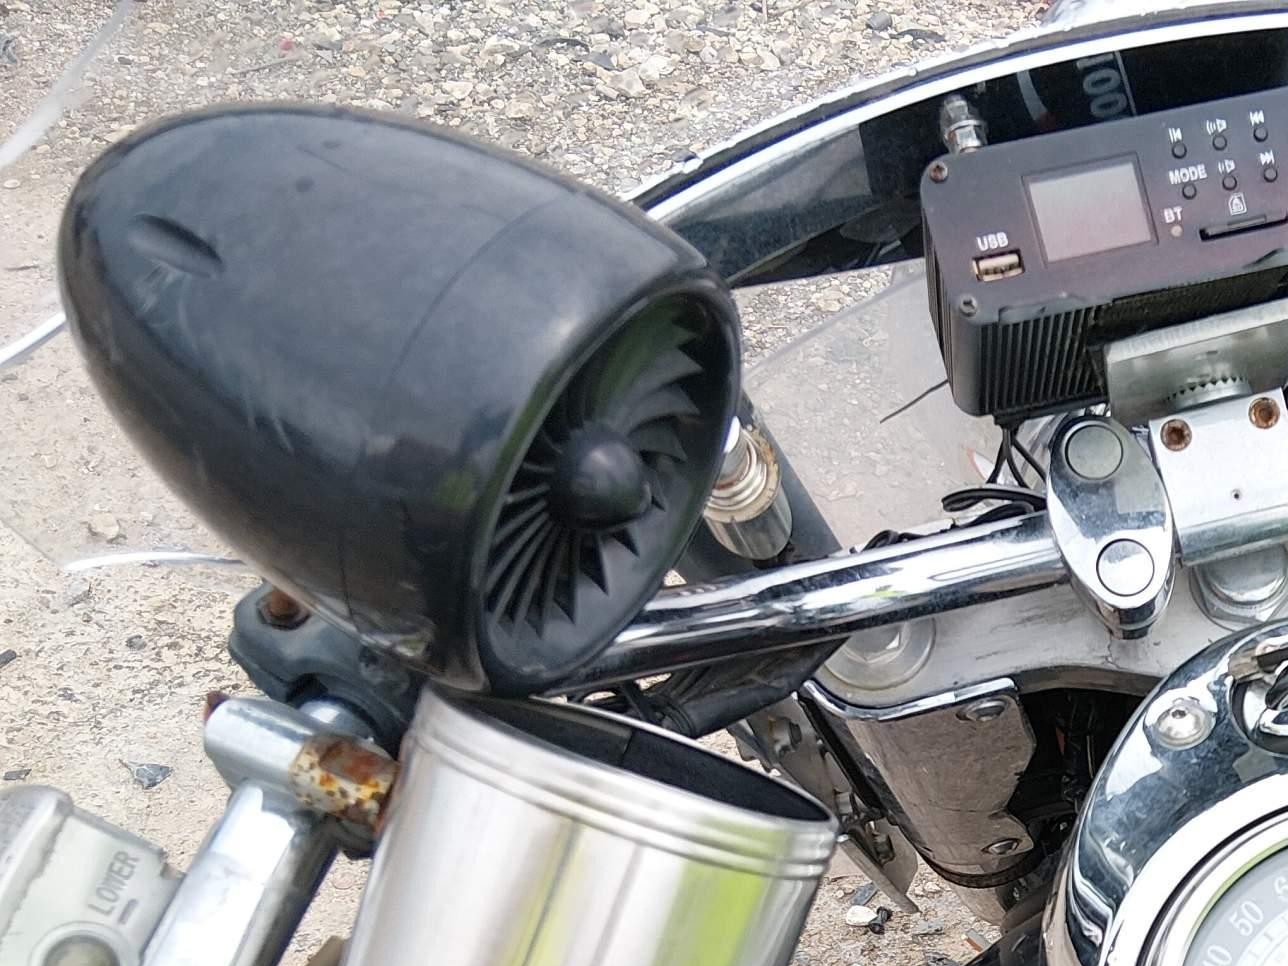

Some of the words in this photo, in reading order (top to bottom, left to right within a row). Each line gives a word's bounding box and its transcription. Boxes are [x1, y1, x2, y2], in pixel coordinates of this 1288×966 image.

[1168, 164, 1208, 184] MODE
[1163, 206, 1183, 224] BT
[976, 232, 1009, 250] USB
[87, 850, 140, 916] LOWER
[1230, 900, 1264, 937] 50
